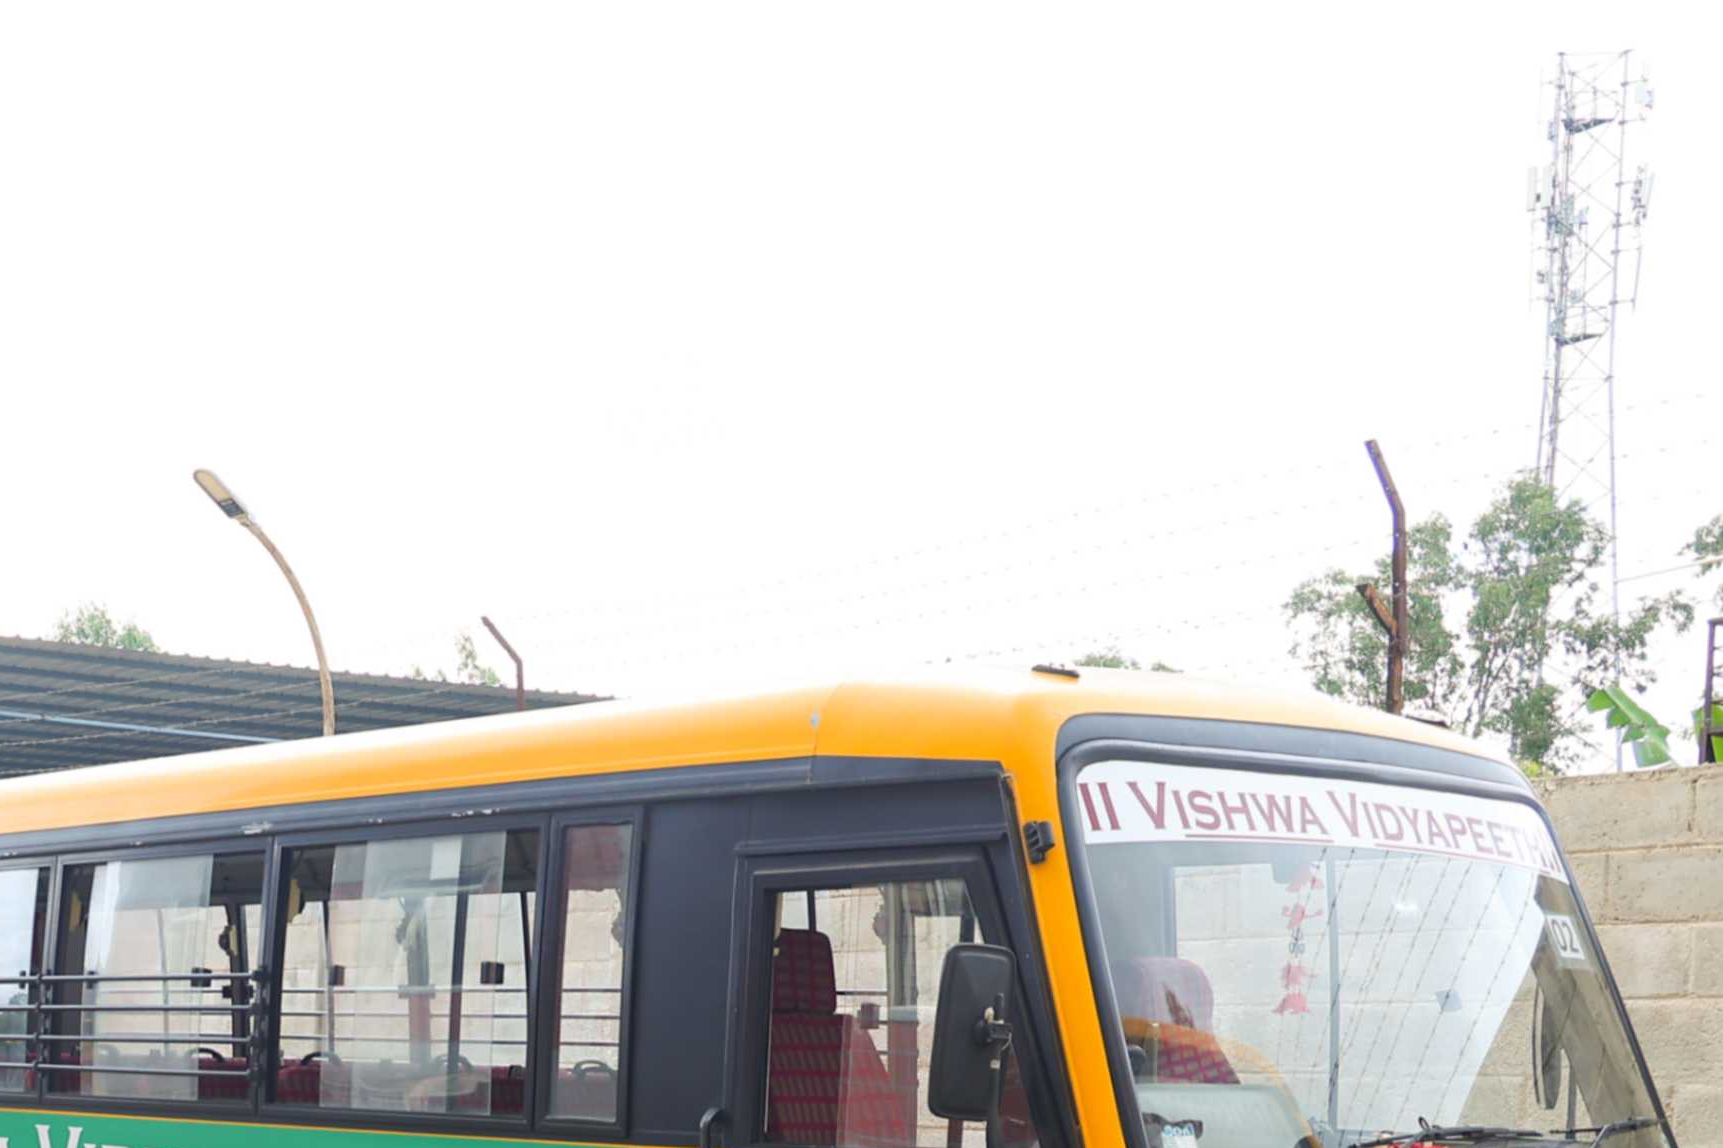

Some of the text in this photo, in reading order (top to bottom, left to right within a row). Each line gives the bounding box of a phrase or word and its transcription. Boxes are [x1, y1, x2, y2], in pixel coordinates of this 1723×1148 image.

[1127, 780, 1328, 834] VISHWA
[1327, 789, 1548, 868] VIDYAPEETH
[1551, 920, 1580, 954] 02
